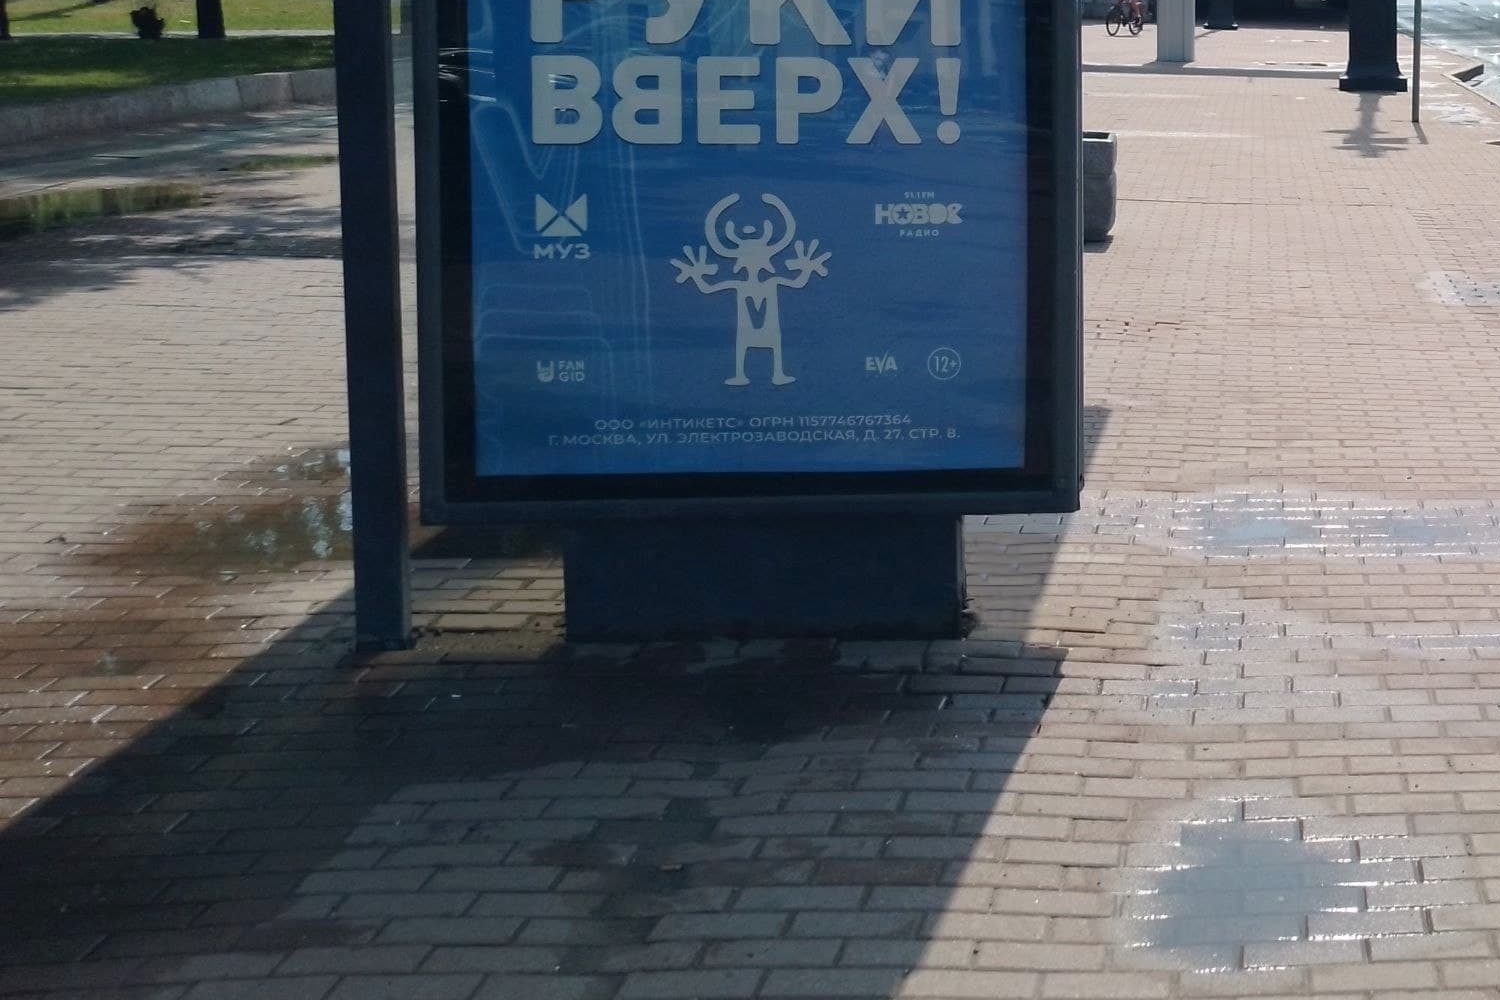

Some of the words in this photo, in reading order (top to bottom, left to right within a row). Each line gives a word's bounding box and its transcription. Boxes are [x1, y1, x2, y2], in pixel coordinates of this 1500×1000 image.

[531, 54, 962, 145] ВВЕРХ!
[899, 229, 940, 238] РАДИО
[533, 242, 591, 260] МУЗ
[559, 360, 585, 370] FAN
[865, 350, 898, 375] EVA
[934, 355, 958, 373] 12+
[559, 371, 585, 382] GID
[594, 419, 634, 430] ООО
[749, 416, 794, 428] ОГРН
[562, 433, 642, 446] МОСКВА,
[678, 429, 860, 443] ЭЛЕКТРОЗАВОДСКАЯ,
